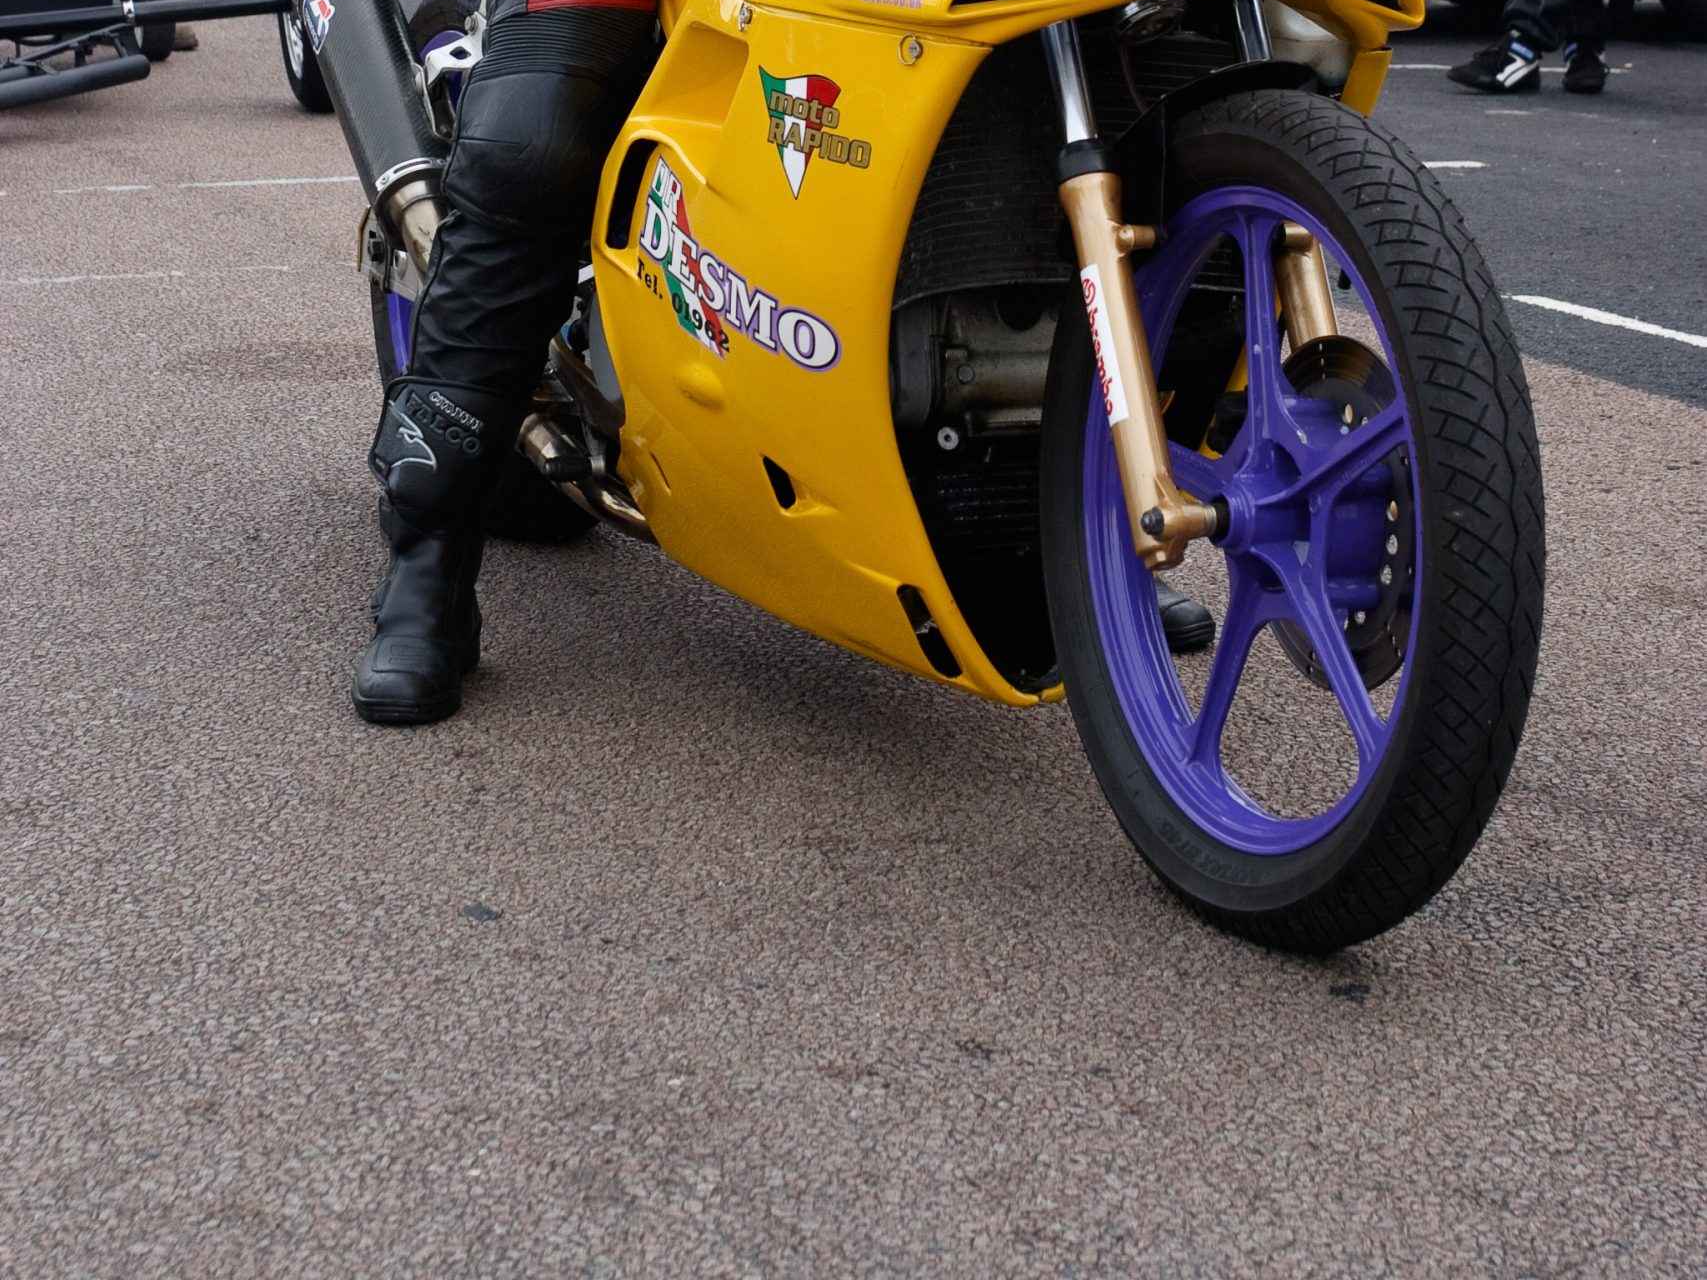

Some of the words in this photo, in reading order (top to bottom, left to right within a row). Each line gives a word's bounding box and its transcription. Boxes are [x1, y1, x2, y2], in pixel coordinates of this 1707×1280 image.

[767, 116, 872, 169] RAPIDO
[651, 156, 682, 216] DR
[637, 256, 665, 300] Tel.
[671, 292, 730, 354] 01962
[639, 194, 841, 371] DESMO
[406, 392, 482, 455] FALCO
